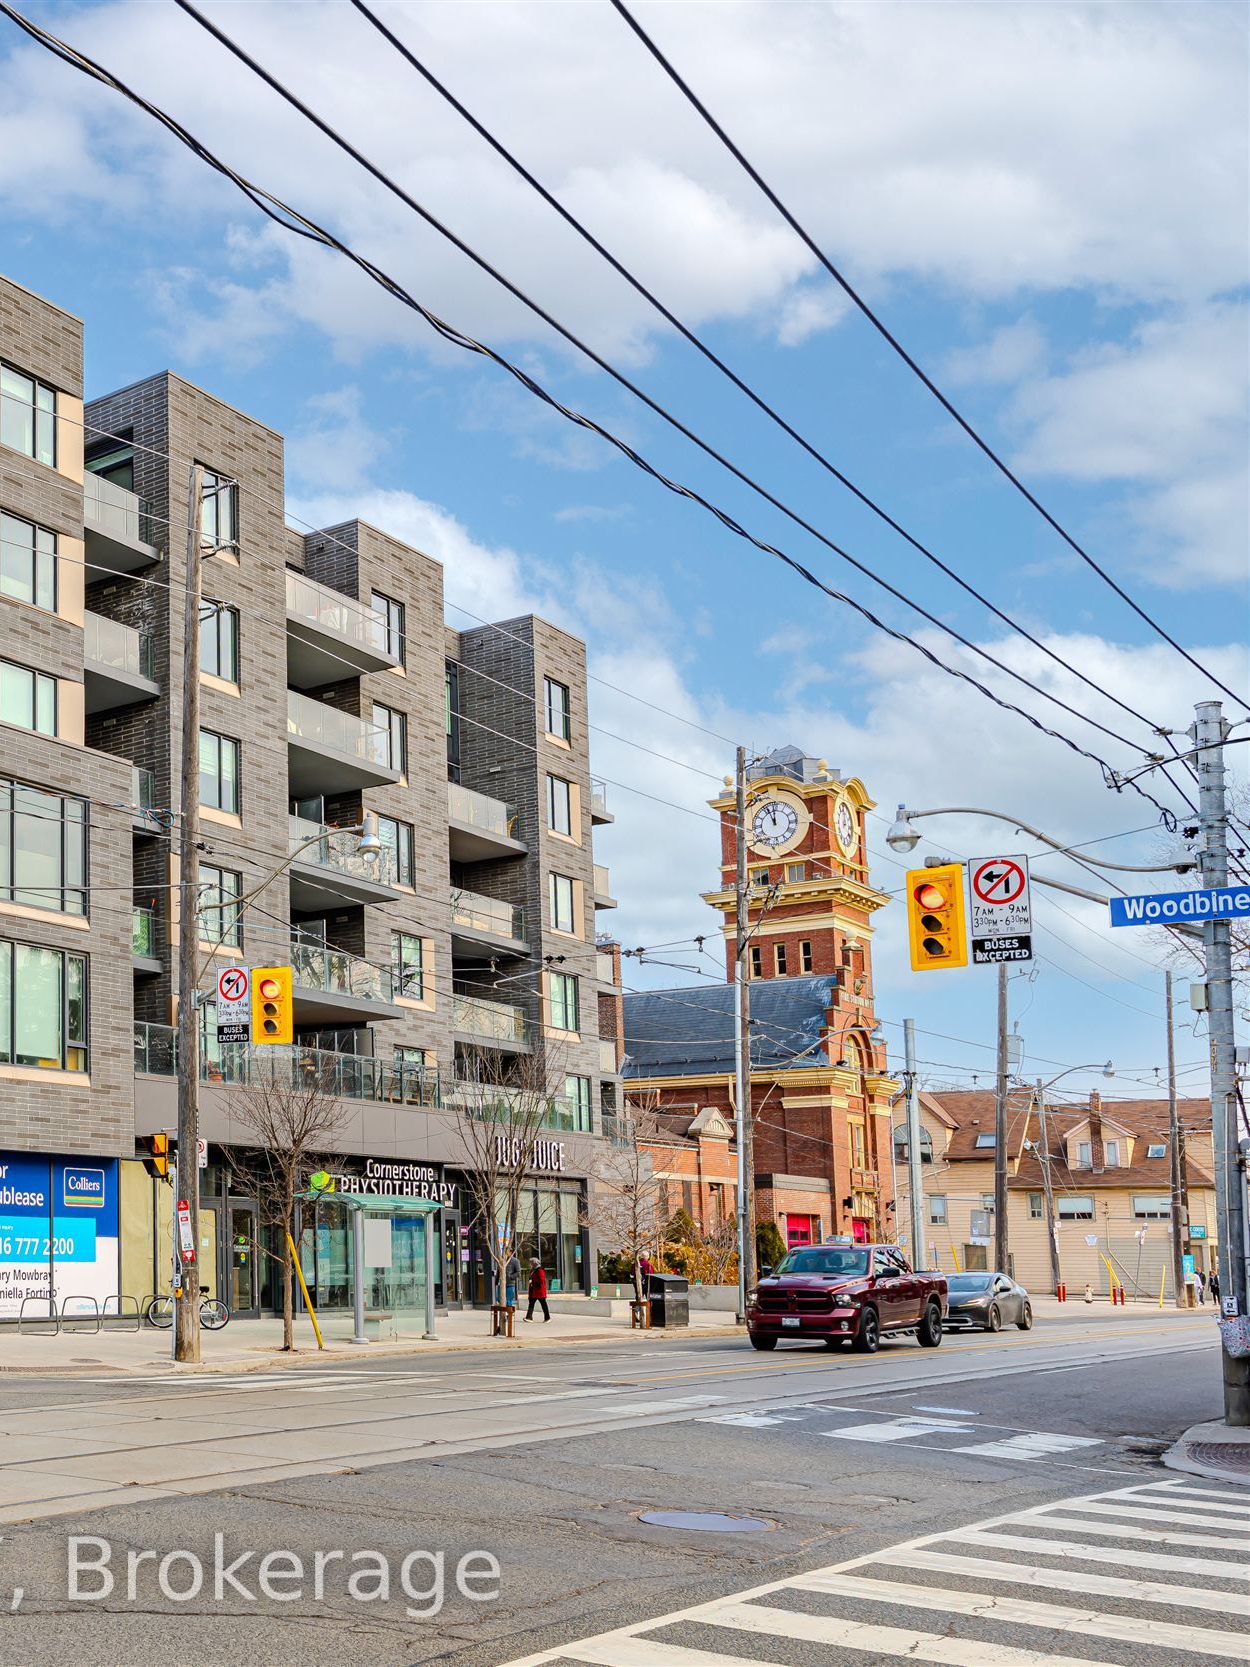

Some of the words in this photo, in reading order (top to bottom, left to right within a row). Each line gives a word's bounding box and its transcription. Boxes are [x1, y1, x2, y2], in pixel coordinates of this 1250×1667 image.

[974, 906, 994, 916] 7AM
[1009, 904, 1027, 913] 9AM
[1123, 891, 1250, 919] Woodbine
[984, 939, 1019, 950] BUSES
[975, 949, 1029, 961] EXCEPTED
[224, 1026, 243, 1034] BUSES
[532, 1140, 565, 1171] JUICE
[366, 1159, 434, 1181] Cornerstone
[68, 1176, 100, 1191] Colliers
[340, 1177, 456, 1201] PHYSIOTHERAPY
[15, 1237, 39, 1255] 777
[42, 1237, 74, 1255] 2200
